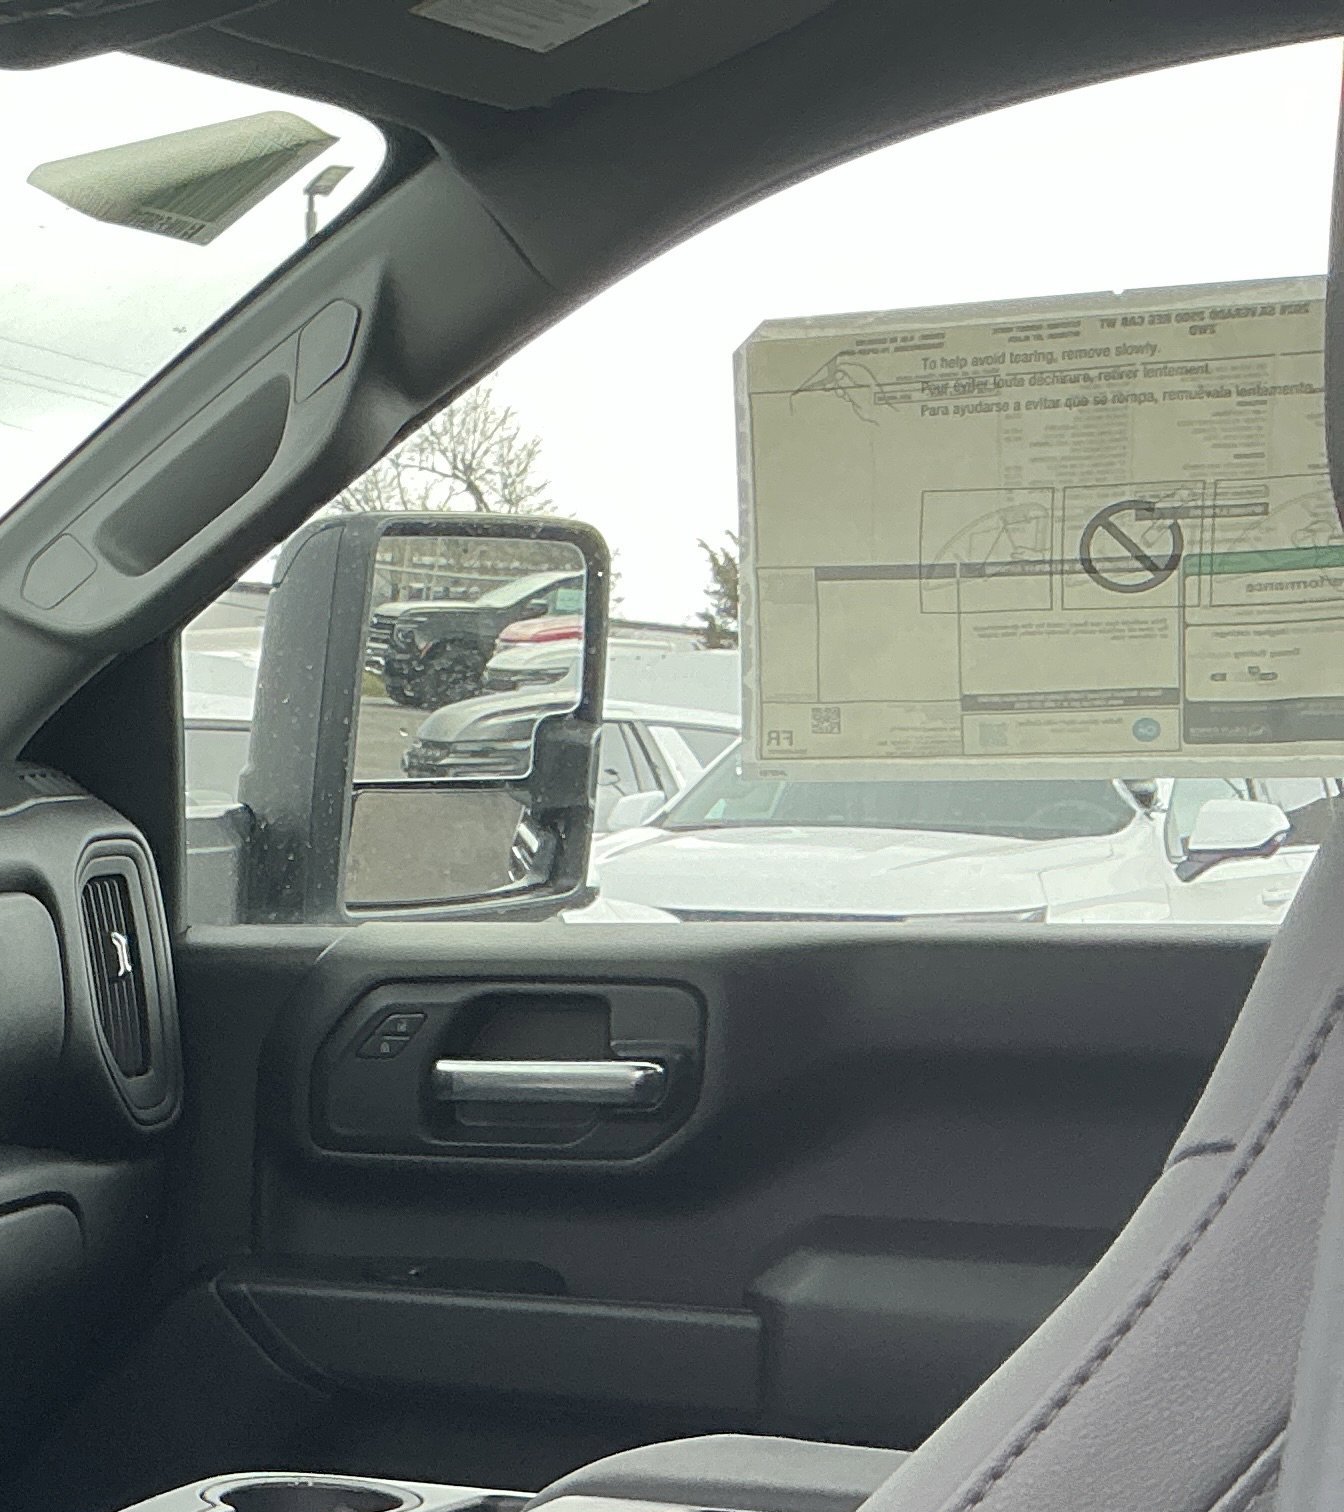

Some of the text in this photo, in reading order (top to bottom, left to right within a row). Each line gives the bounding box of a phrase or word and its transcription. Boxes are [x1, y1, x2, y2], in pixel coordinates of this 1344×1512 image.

[921, 357, 937, 371] To
[940, 355, 968, 370] help
[971, 353, 1006, 368] avoid
[1009, 350, 1058, 365] tearing,
[1062, 346, 1111, 361] remove
